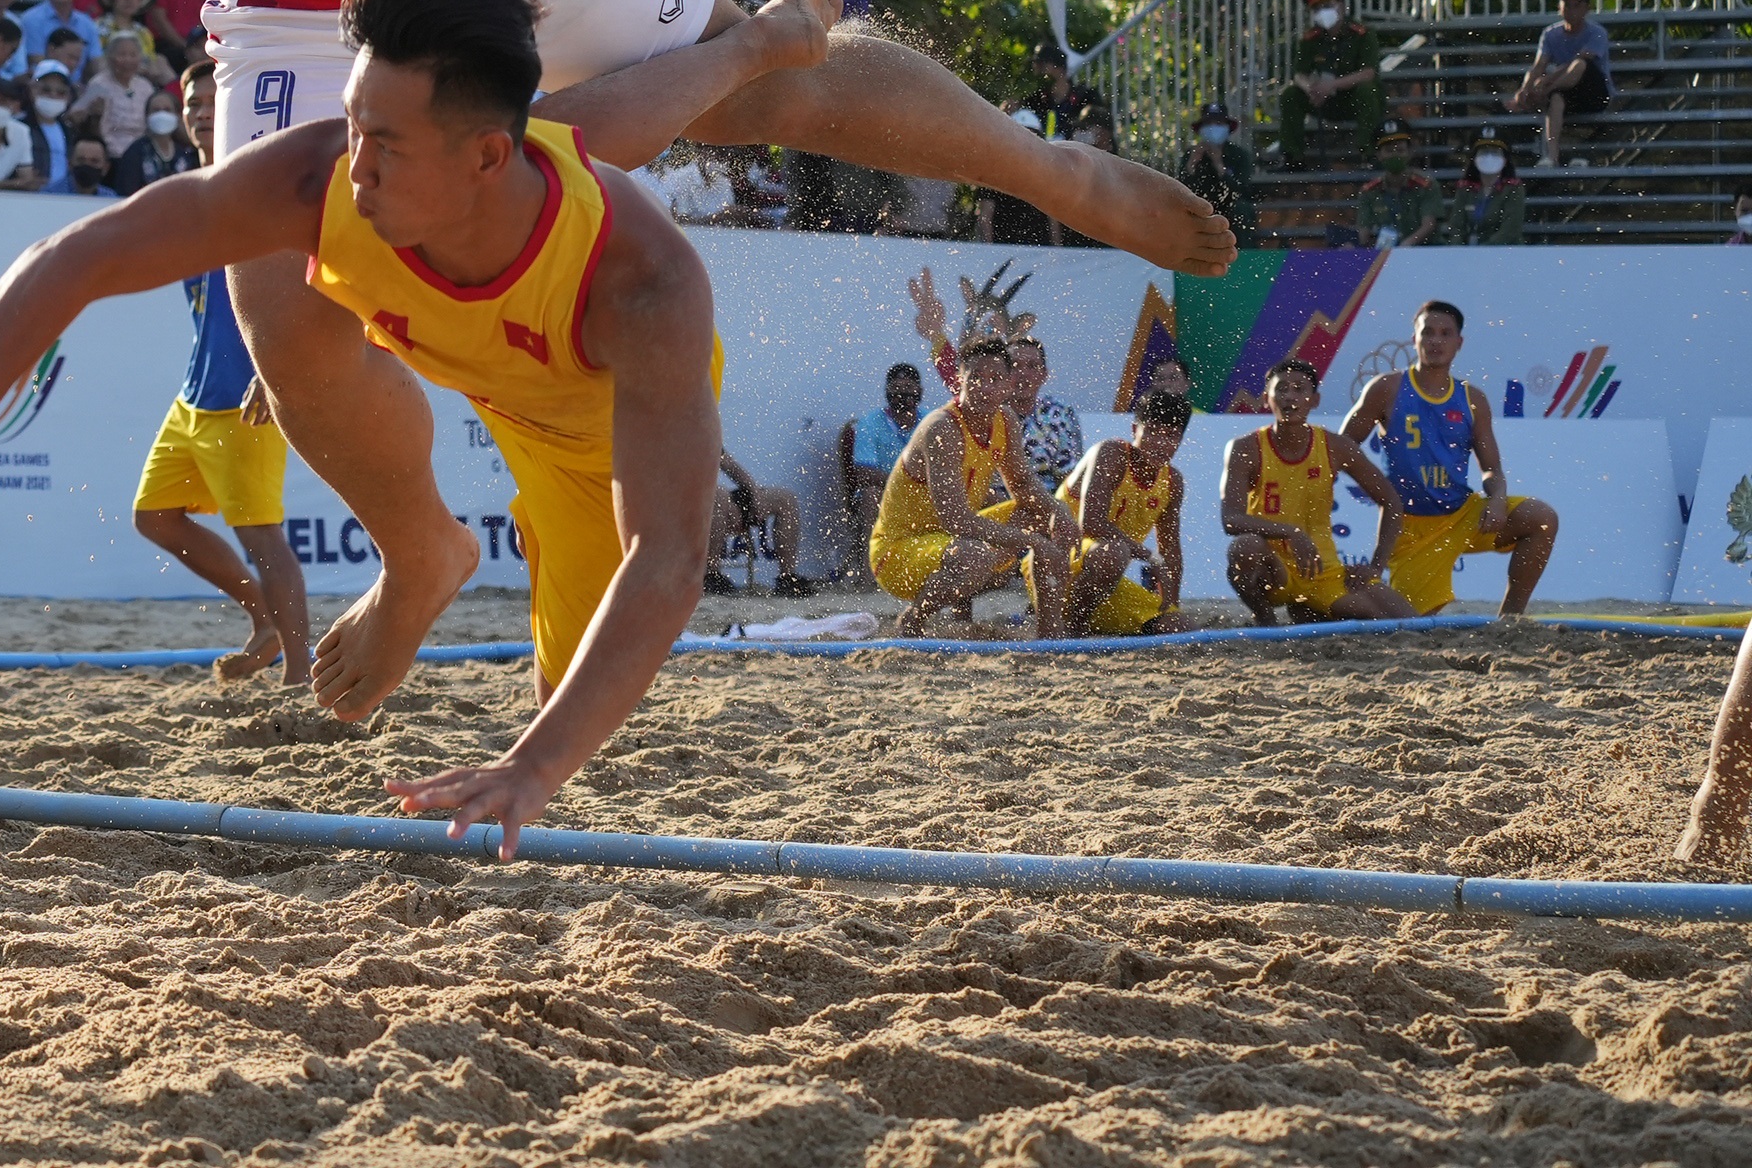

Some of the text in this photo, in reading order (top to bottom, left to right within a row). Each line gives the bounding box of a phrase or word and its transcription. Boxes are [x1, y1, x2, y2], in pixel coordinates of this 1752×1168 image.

[251, 70, 295, 141] 9
[1405, 414, 1421, 449] 5
[1264, 482, 1280, 514] 6
